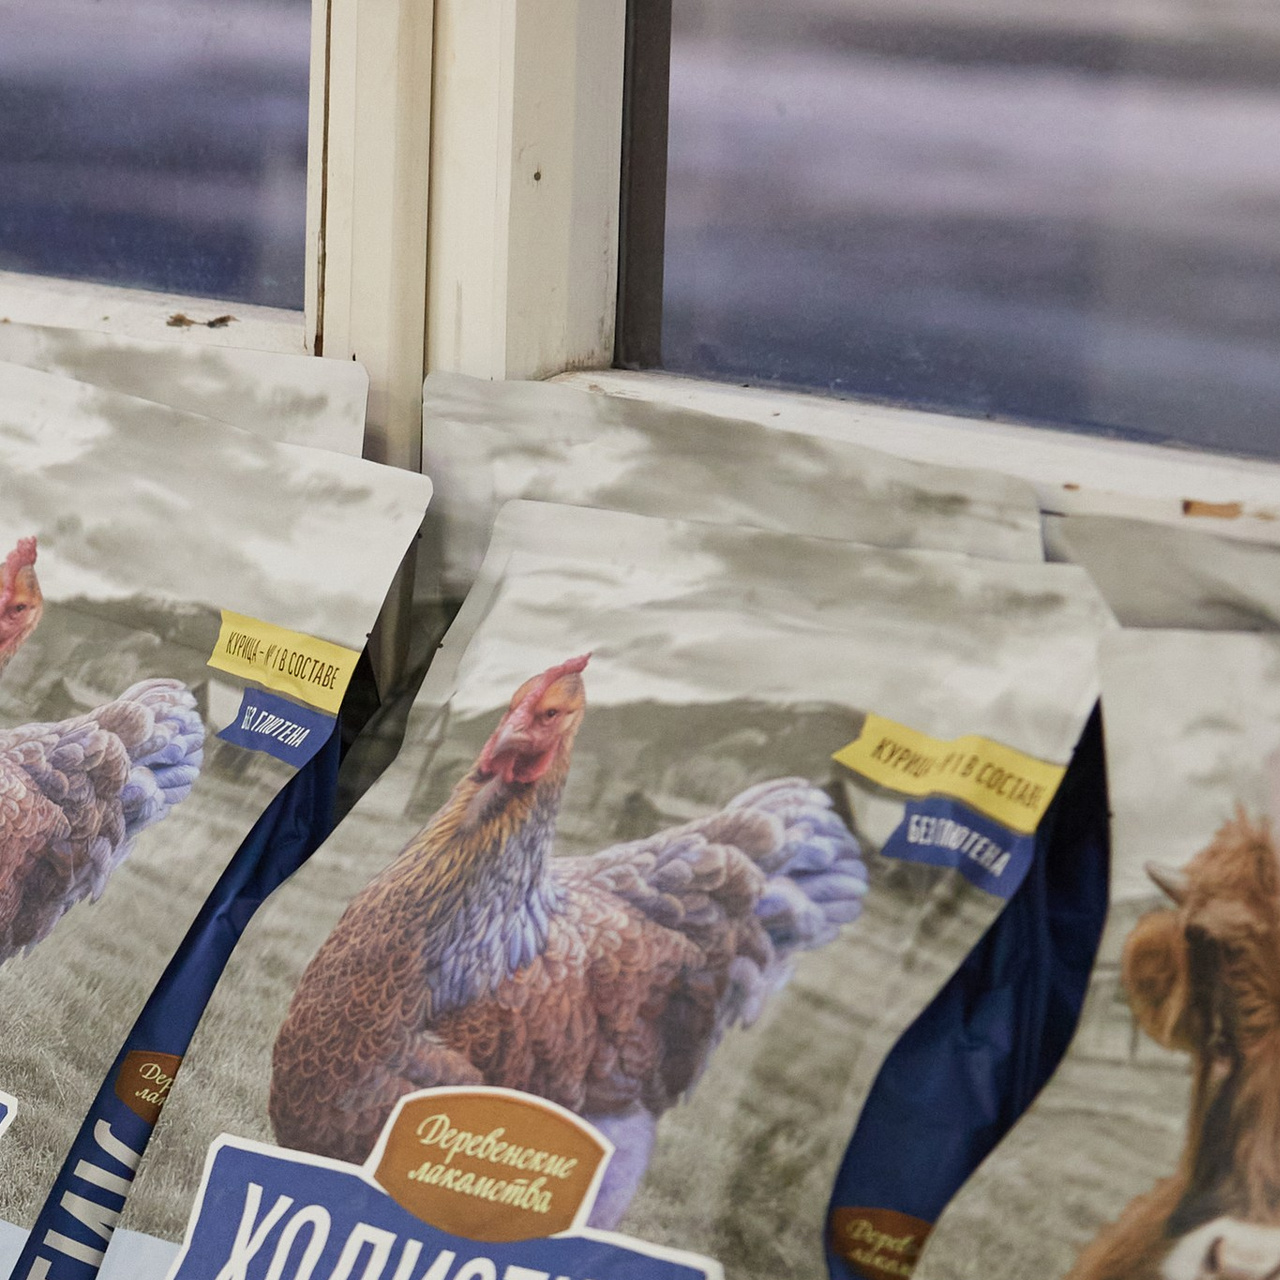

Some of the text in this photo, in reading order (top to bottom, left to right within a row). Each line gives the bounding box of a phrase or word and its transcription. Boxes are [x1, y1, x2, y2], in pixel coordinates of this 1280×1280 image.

[226, 632, 261, 664] КУРИЦА
[279, 649, 288, 672] В
[288, 652, 340, 690] СОСТАВЕ
[253, 711, 310, 748] ГЛЮТЕНА
[415, 1111, 581, 1184] Деревенские
[408, 1156, 553, 1216] лакомства
